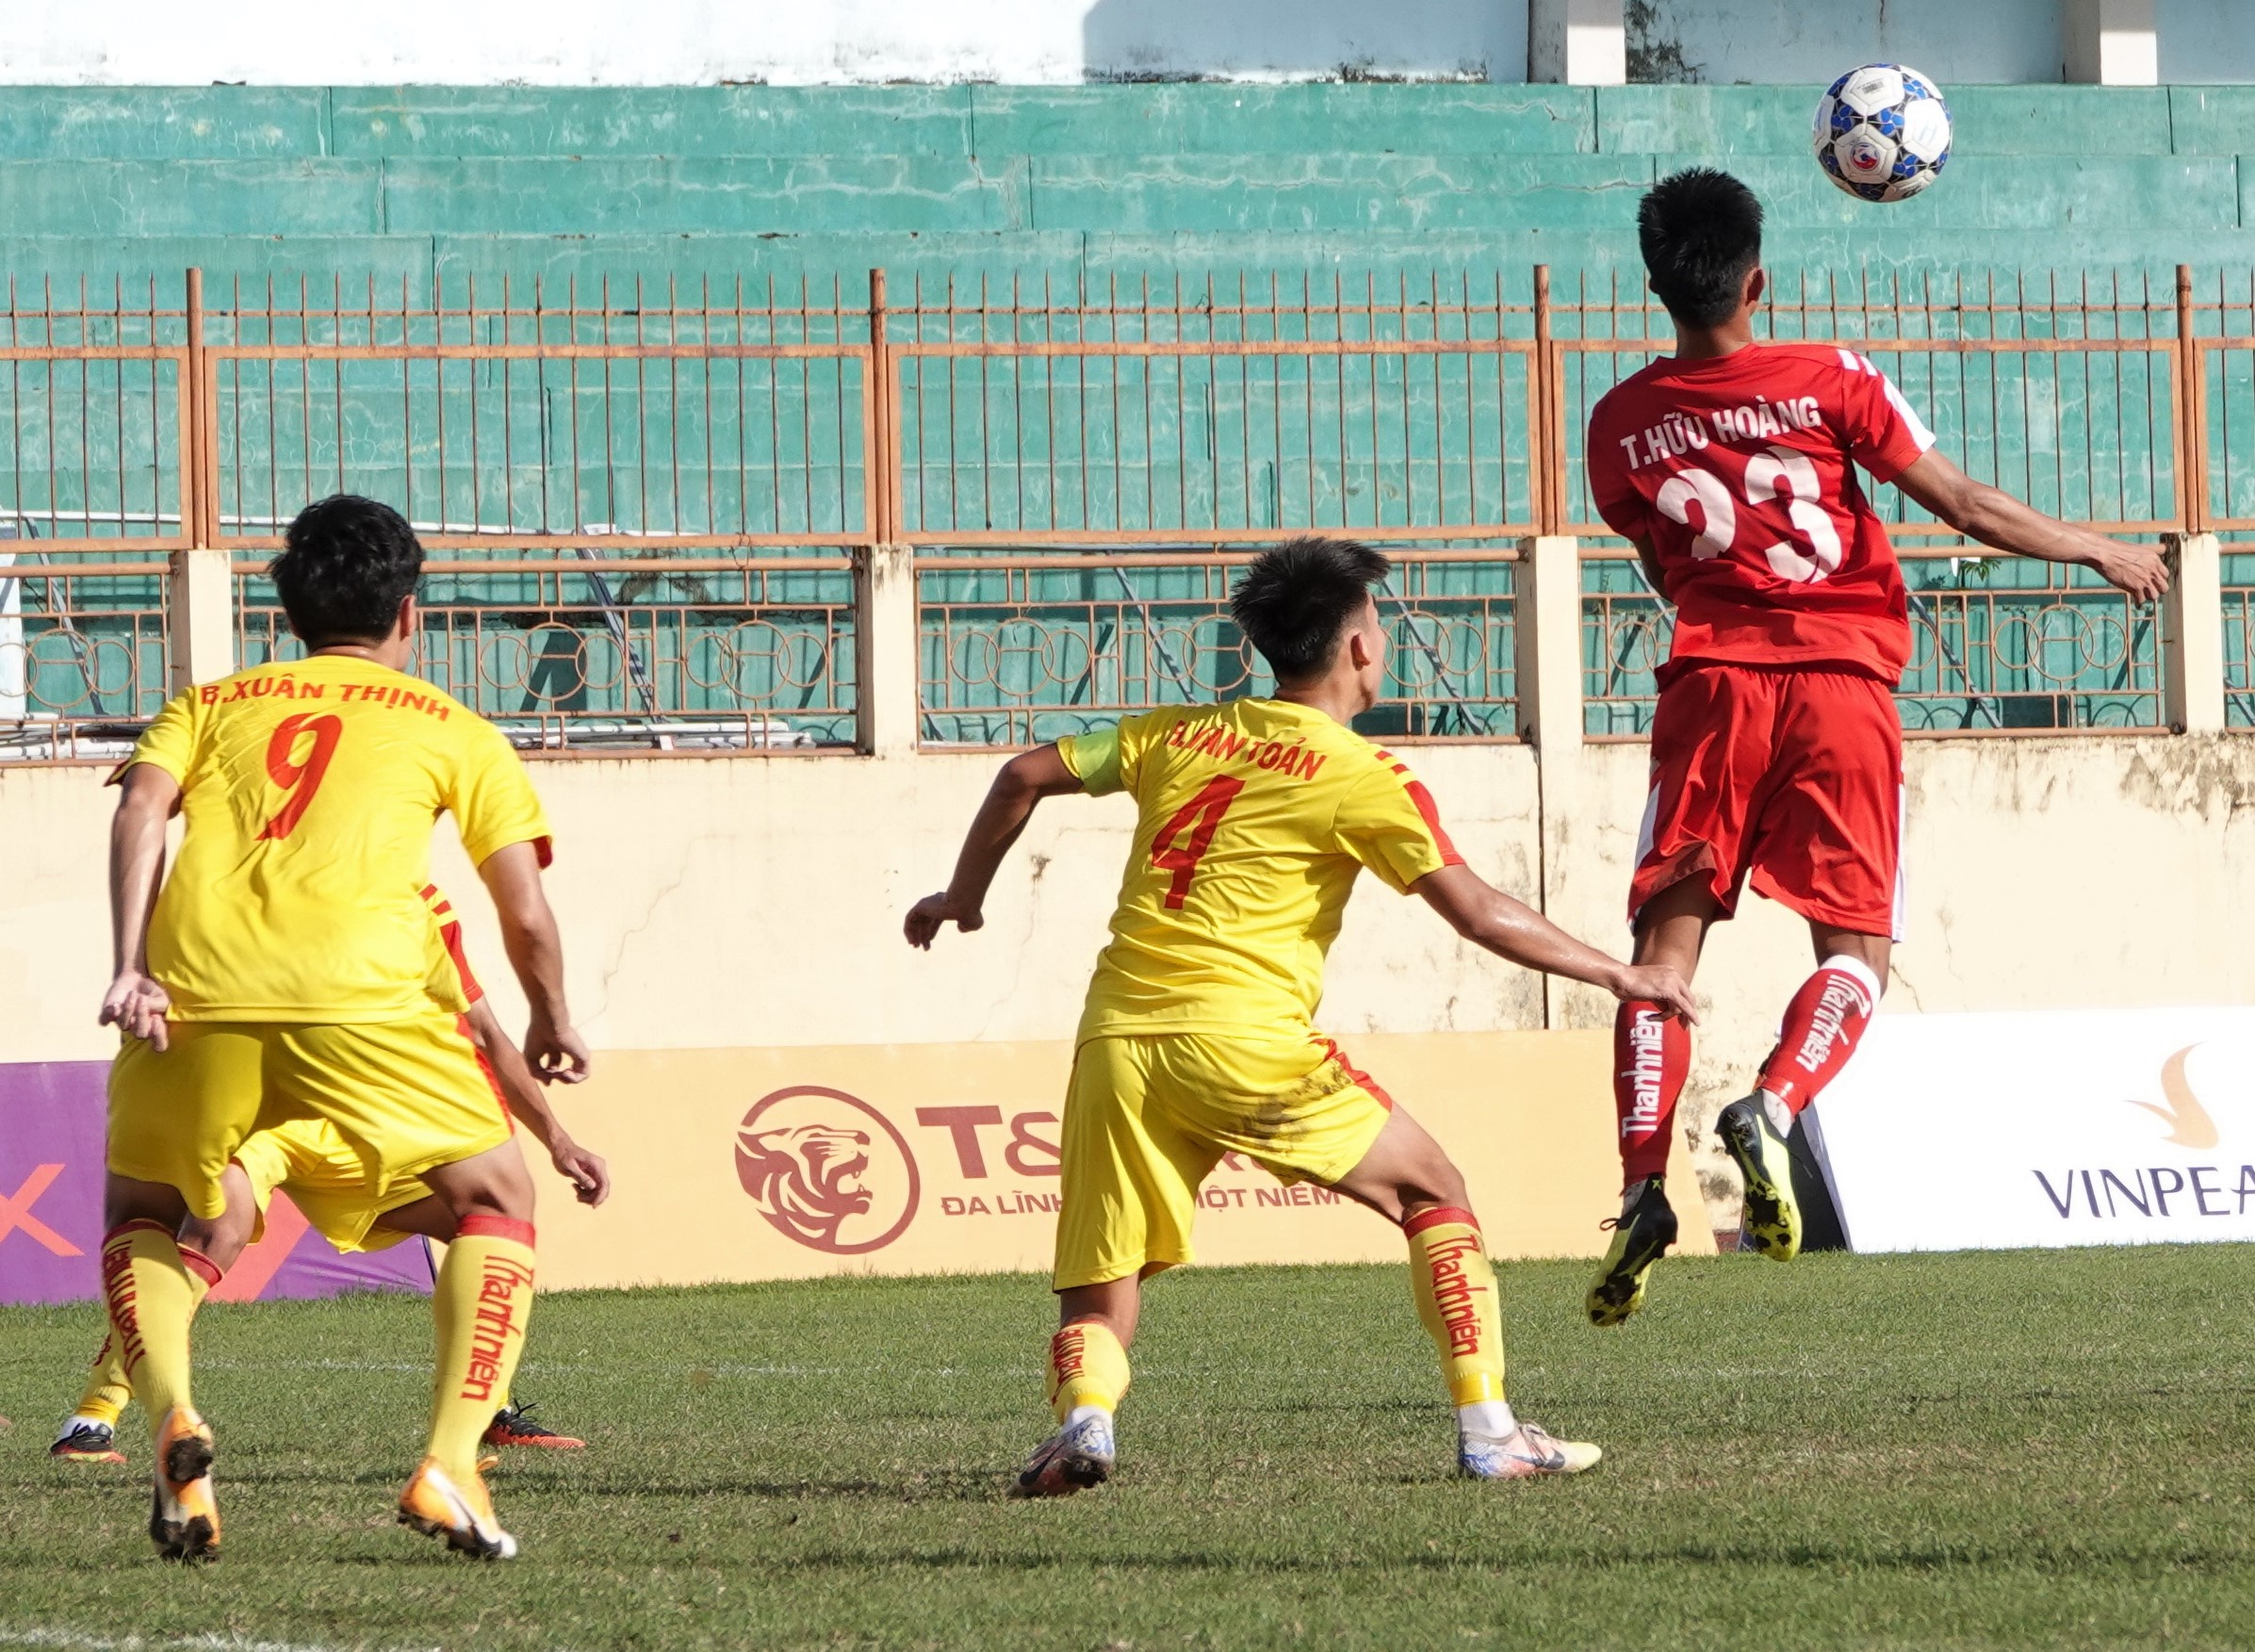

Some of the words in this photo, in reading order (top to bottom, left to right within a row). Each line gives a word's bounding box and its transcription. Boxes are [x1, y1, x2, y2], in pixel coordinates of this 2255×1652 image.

[1711, 395, 1822, 443] HOÀNG
[200, 674, 327, 706] B.XUÂN
[340, 683, 451, 722] THỊNH
[255, 712, 343, 842] 9
[1151, 774, 1248, 910] 4
[915, 1104, 1062, 1180] T&
[940, 1196, 992, 1217] ĐA
[1196, 1185, 1247, 1213] ỘT
